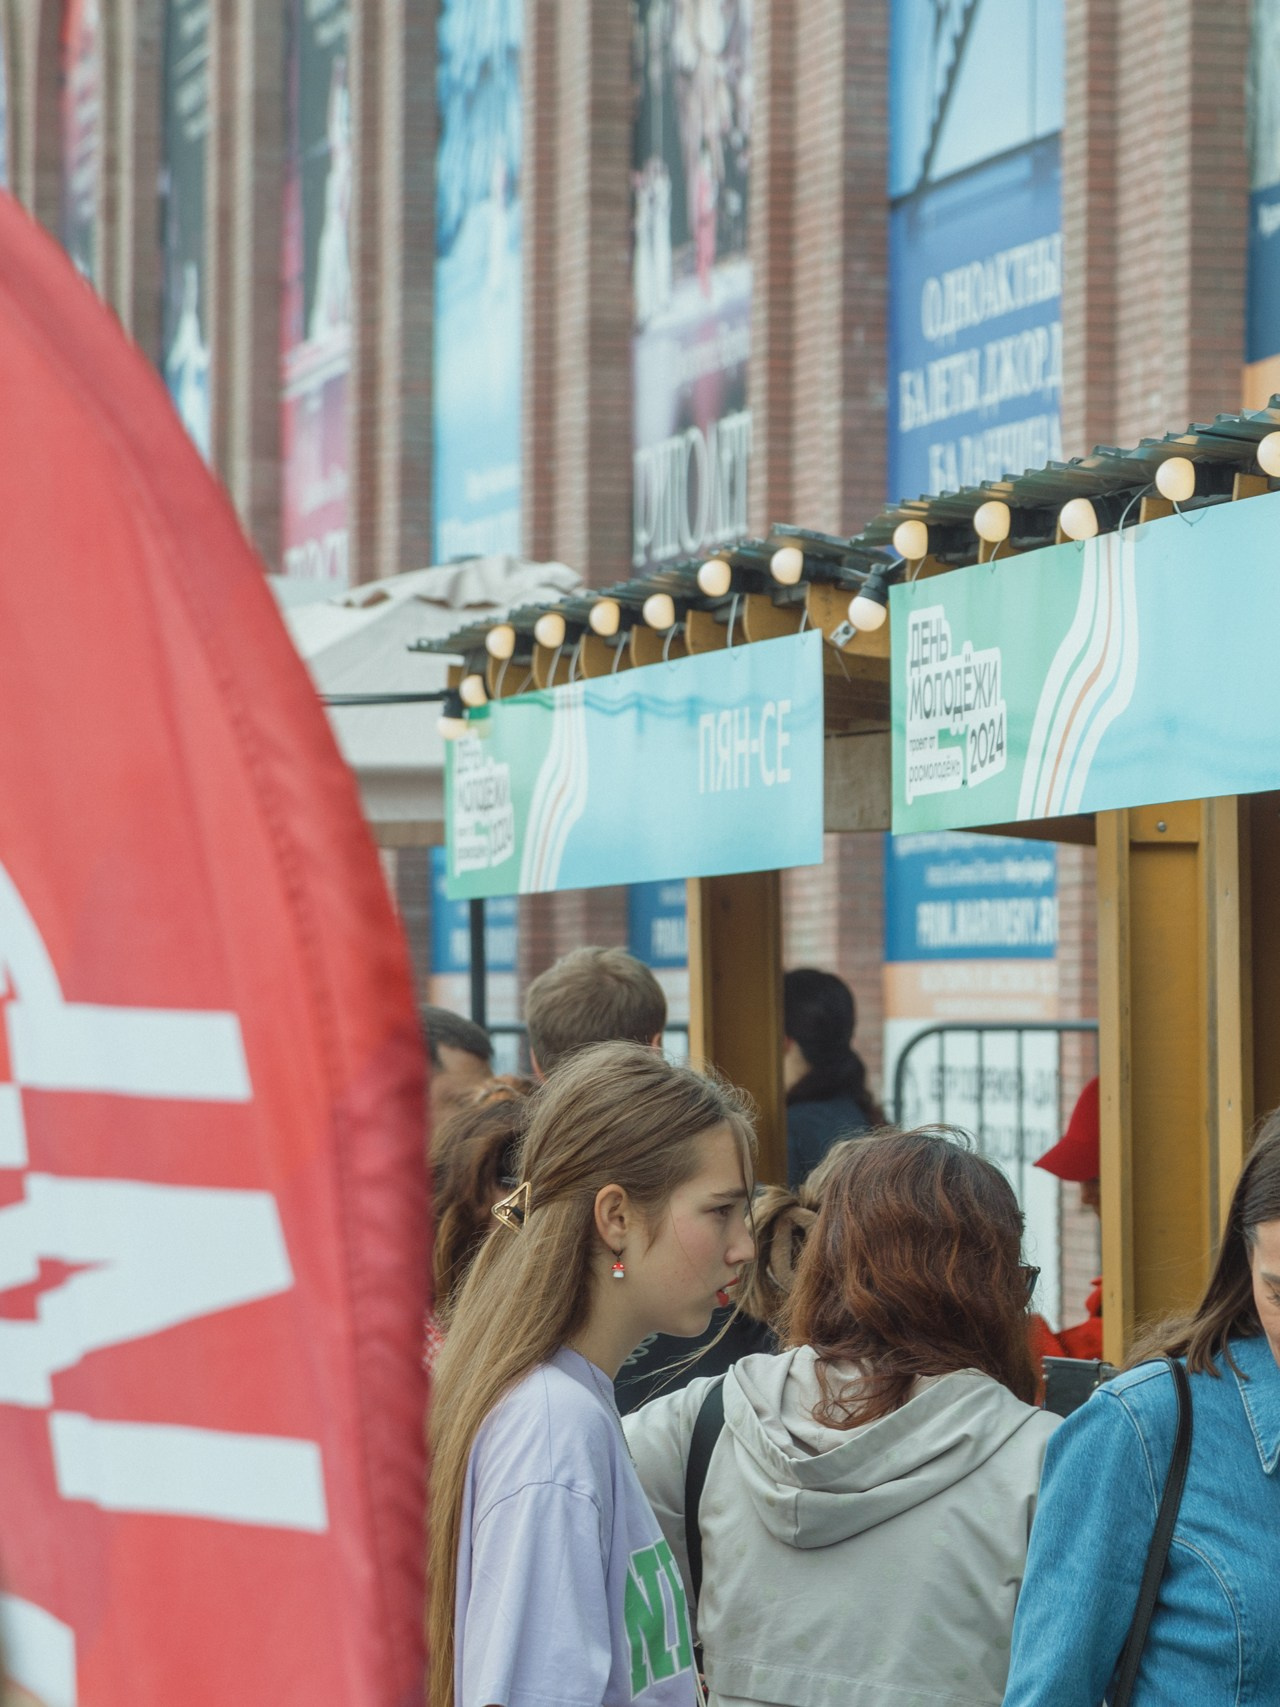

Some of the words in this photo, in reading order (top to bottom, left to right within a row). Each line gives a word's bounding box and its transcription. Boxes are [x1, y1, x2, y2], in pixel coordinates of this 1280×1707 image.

[910, 618, 948, 676] ДЕНЬ
[910, 653, 998, 722] МОЛОДЁЖИ
[699, 698, 791, 794] ПЯН-СЕ
[970, 712, 1004, 774] 2024
